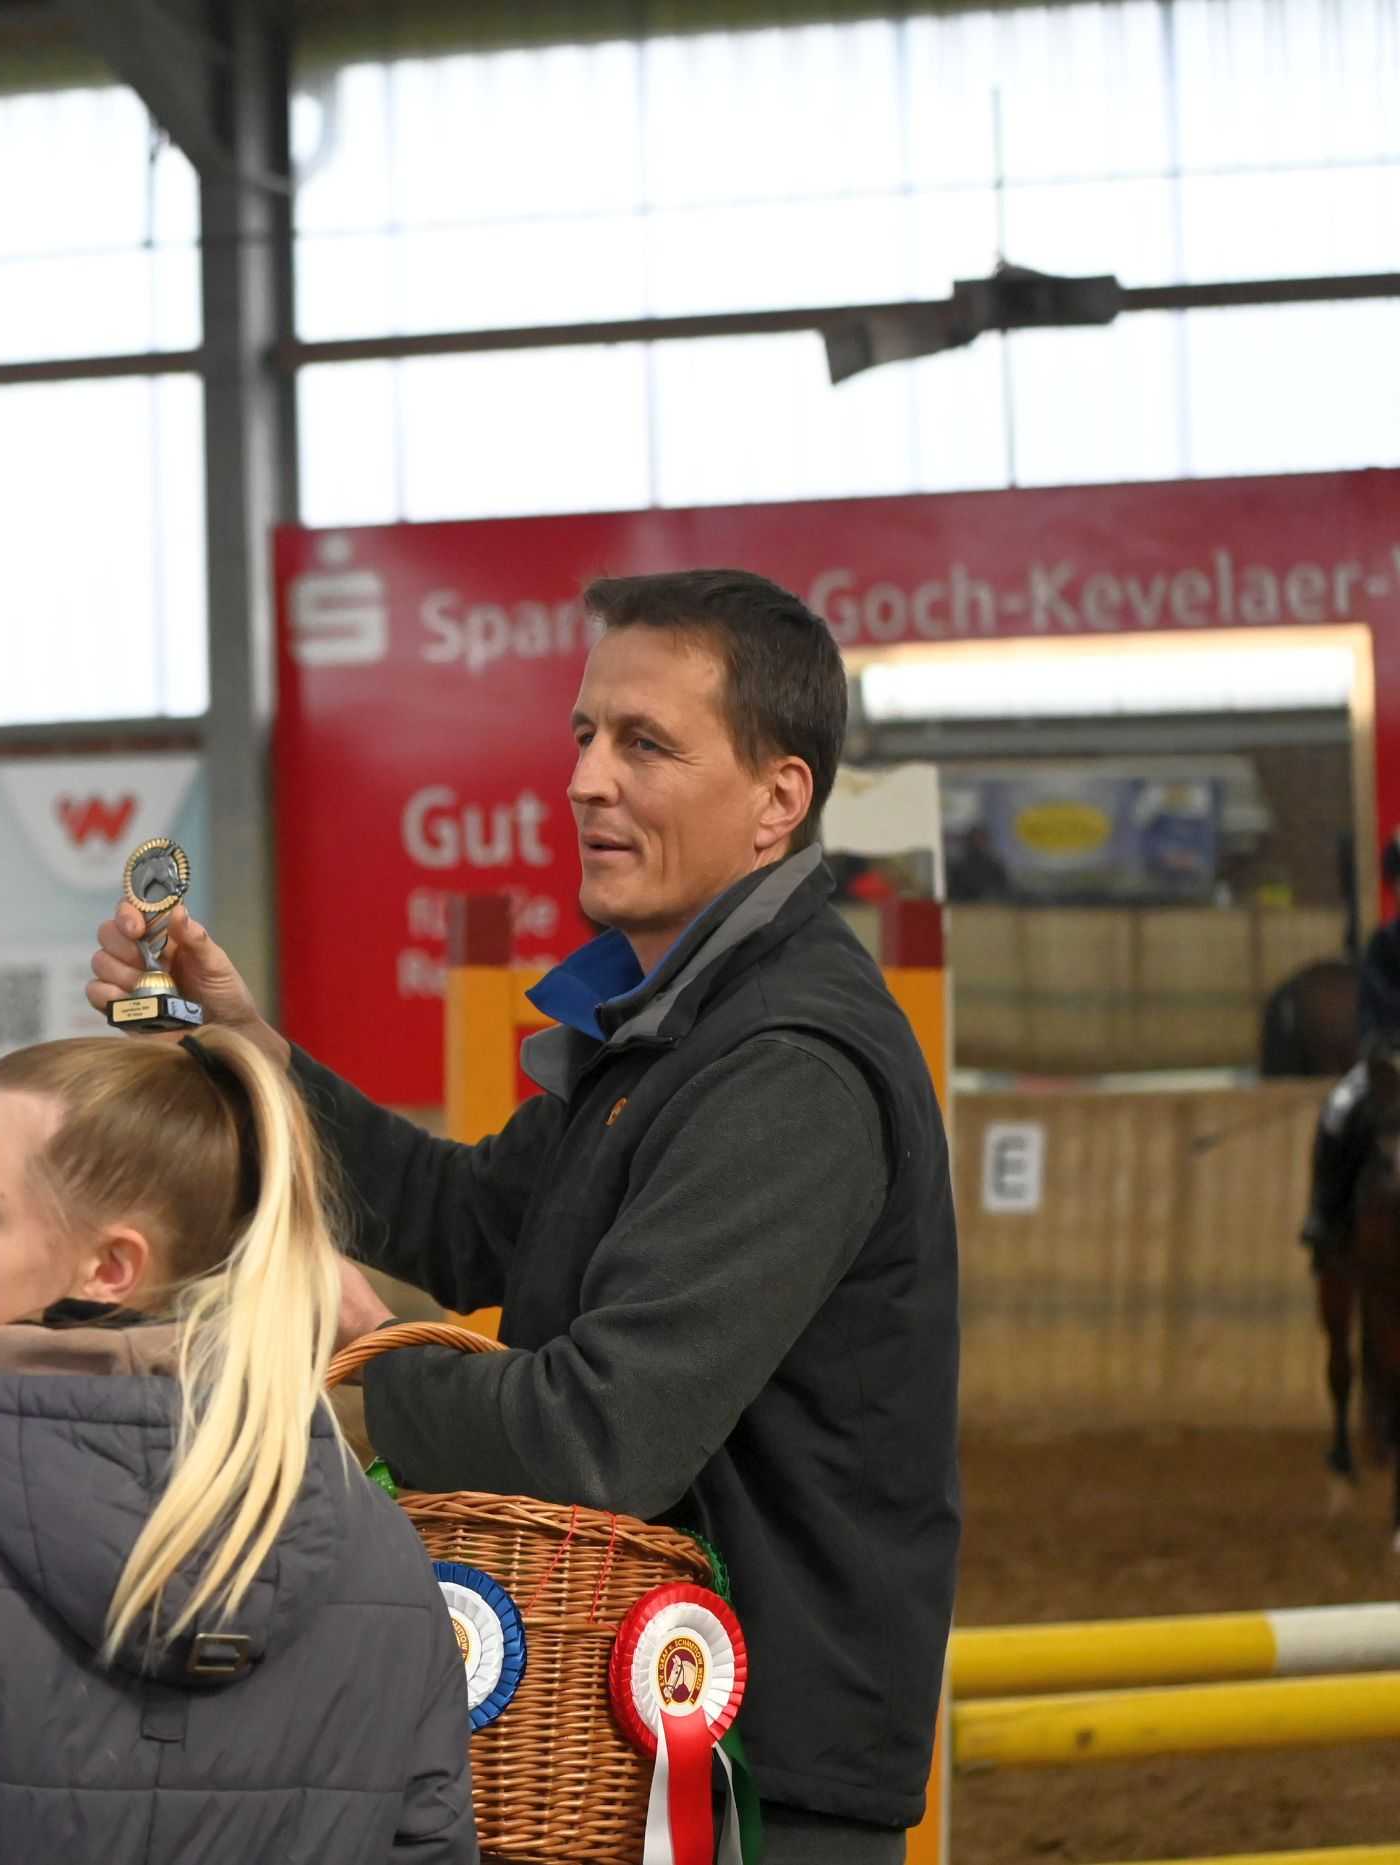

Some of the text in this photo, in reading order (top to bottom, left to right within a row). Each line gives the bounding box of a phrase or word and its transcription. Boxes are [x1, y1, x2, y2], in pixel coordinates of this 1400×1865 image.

[809, 548, 1400, 642] Goch-Kevelaer-
[403, 785, 553, 869] Gut
[993, 1136, 1028, 1200] E
